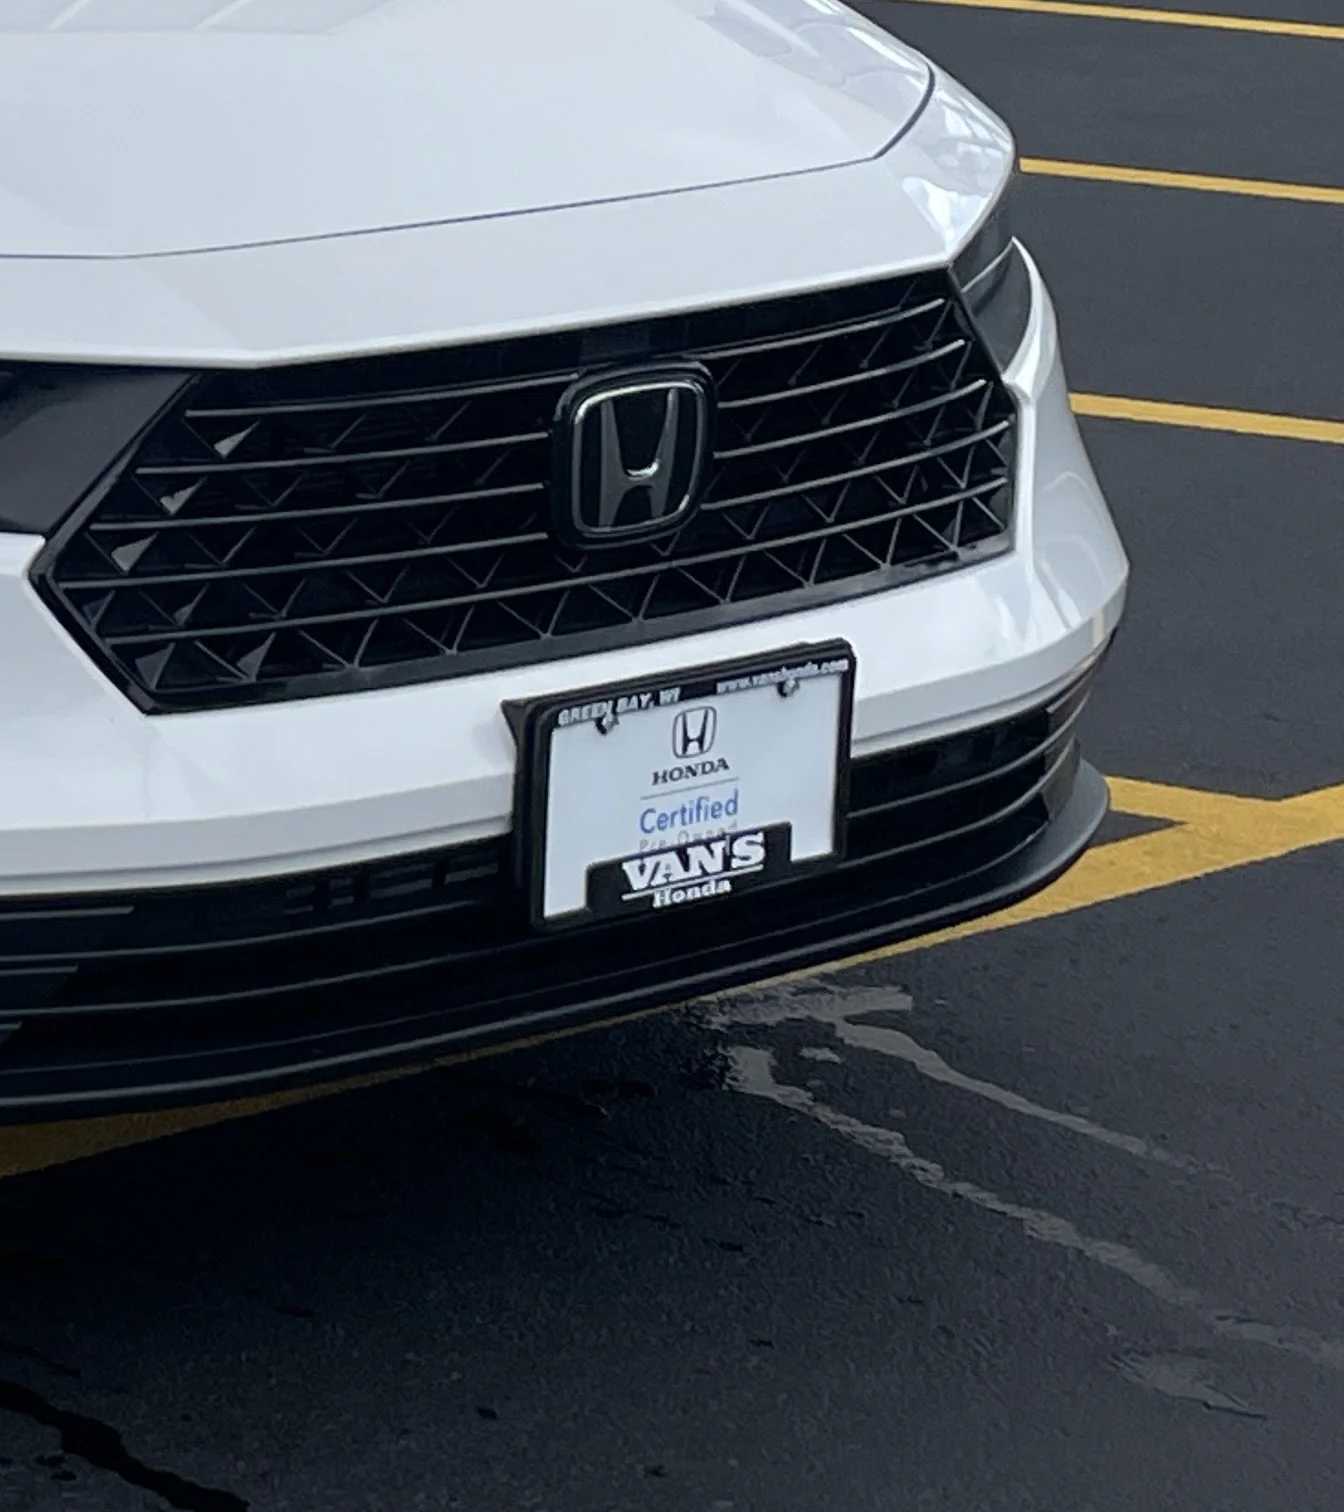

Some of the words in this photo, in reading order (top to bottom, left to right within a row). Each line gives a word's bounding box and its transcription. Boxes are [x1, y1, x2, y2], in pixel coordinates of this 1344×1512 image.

[652, 757, 730, 786] HONDA
[640, 788, 739, 834] Certified
[652, 879, 732, 908] Honda
